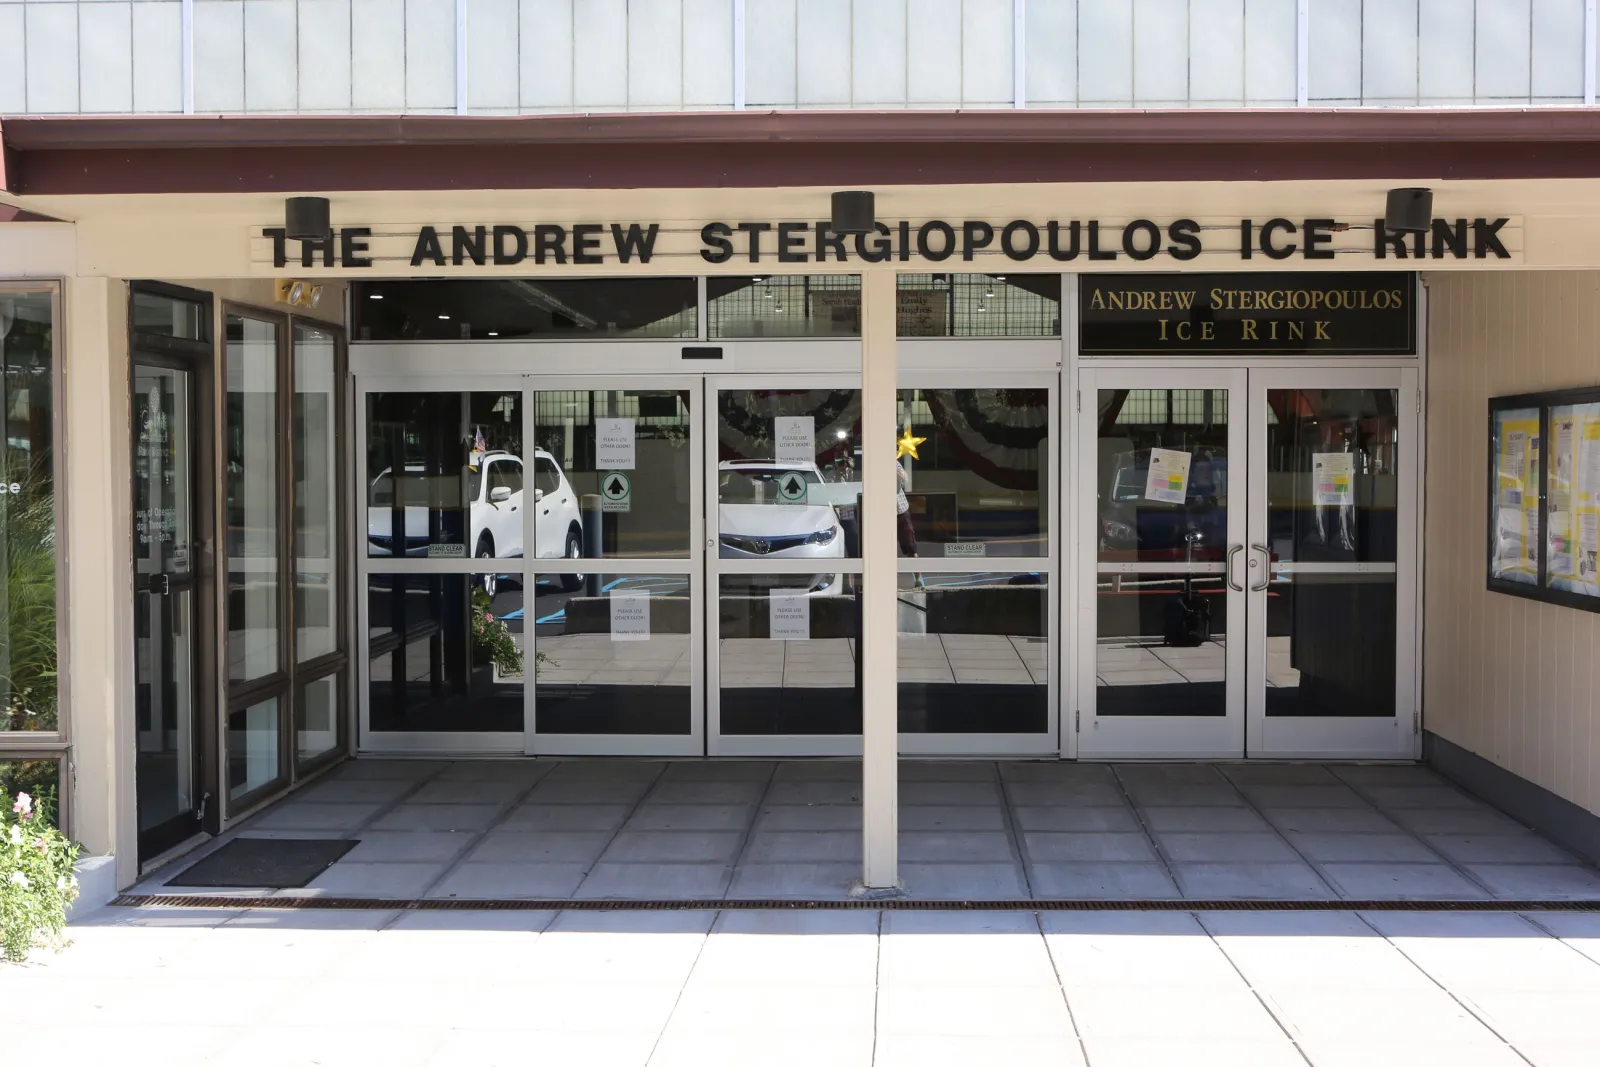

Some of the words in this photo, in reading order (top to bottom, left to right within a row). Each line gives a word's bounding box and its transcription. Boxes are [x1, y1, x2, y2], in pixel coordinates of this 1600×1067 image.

[262, 227, 372, 268] THE
[410, 223, 660, 267] ANDREW
[699, 219, 1202, 264] STERGIOPOULOS
[1240, 218, 1335, 260] ICE
[1374, 218, 1512, 260] RINK
[1088, 288, 1197, 311] ANDREW
[1210, 288, 1403, 311] STERGIOPOULOS
[1158, 319, 1216, 341] ICE
[1241, 319, 1332, 341] RINK
